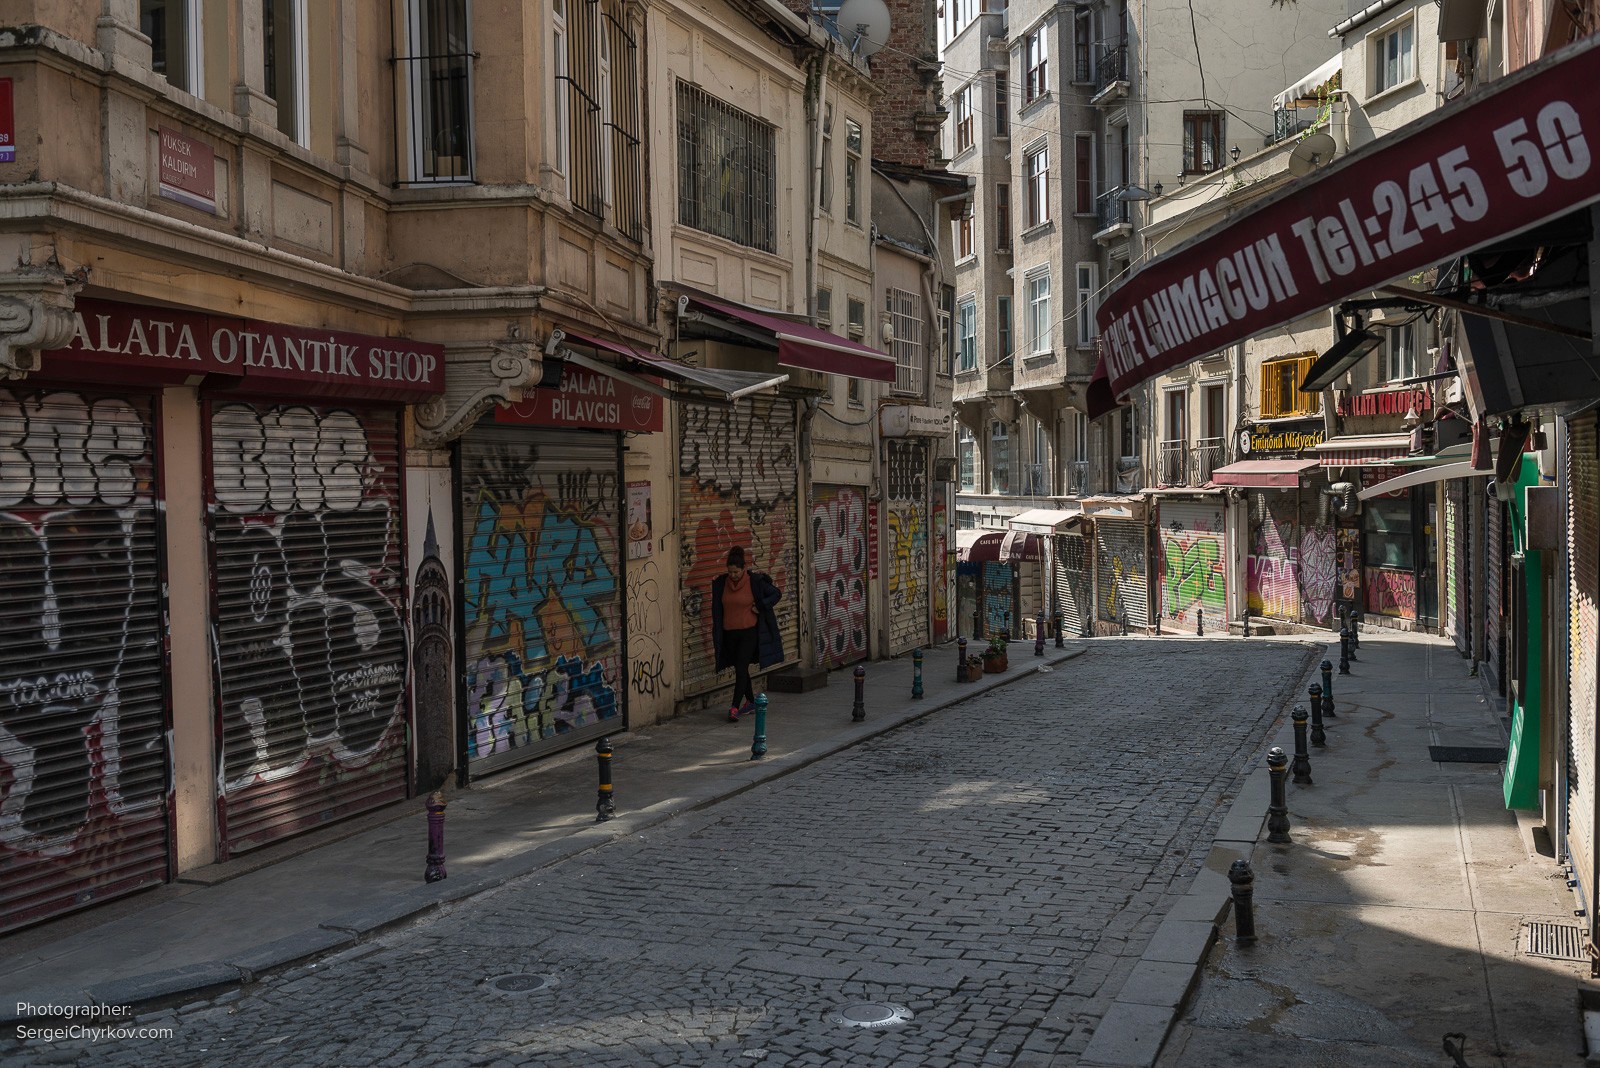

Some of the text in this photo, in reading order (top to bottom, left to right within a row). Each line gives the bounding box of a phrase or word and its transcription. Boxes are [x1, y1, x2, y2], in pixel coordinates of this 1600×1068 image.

[162, 133, 192, 157] YÜKSEK
[162, 154, 197, 179] KALDIRM
[1132, 233, 1300, 359] LAHMACUN
[1493, 101, 1591, 198] 50
[63, 310, 437, 384] ALATA OTANTİK SHOP
[560, 370, 616, 397] GALATA
[552, 393, 620, 424] PİLAVCISI
[1251, 433, 1283, 450] Eminönü
